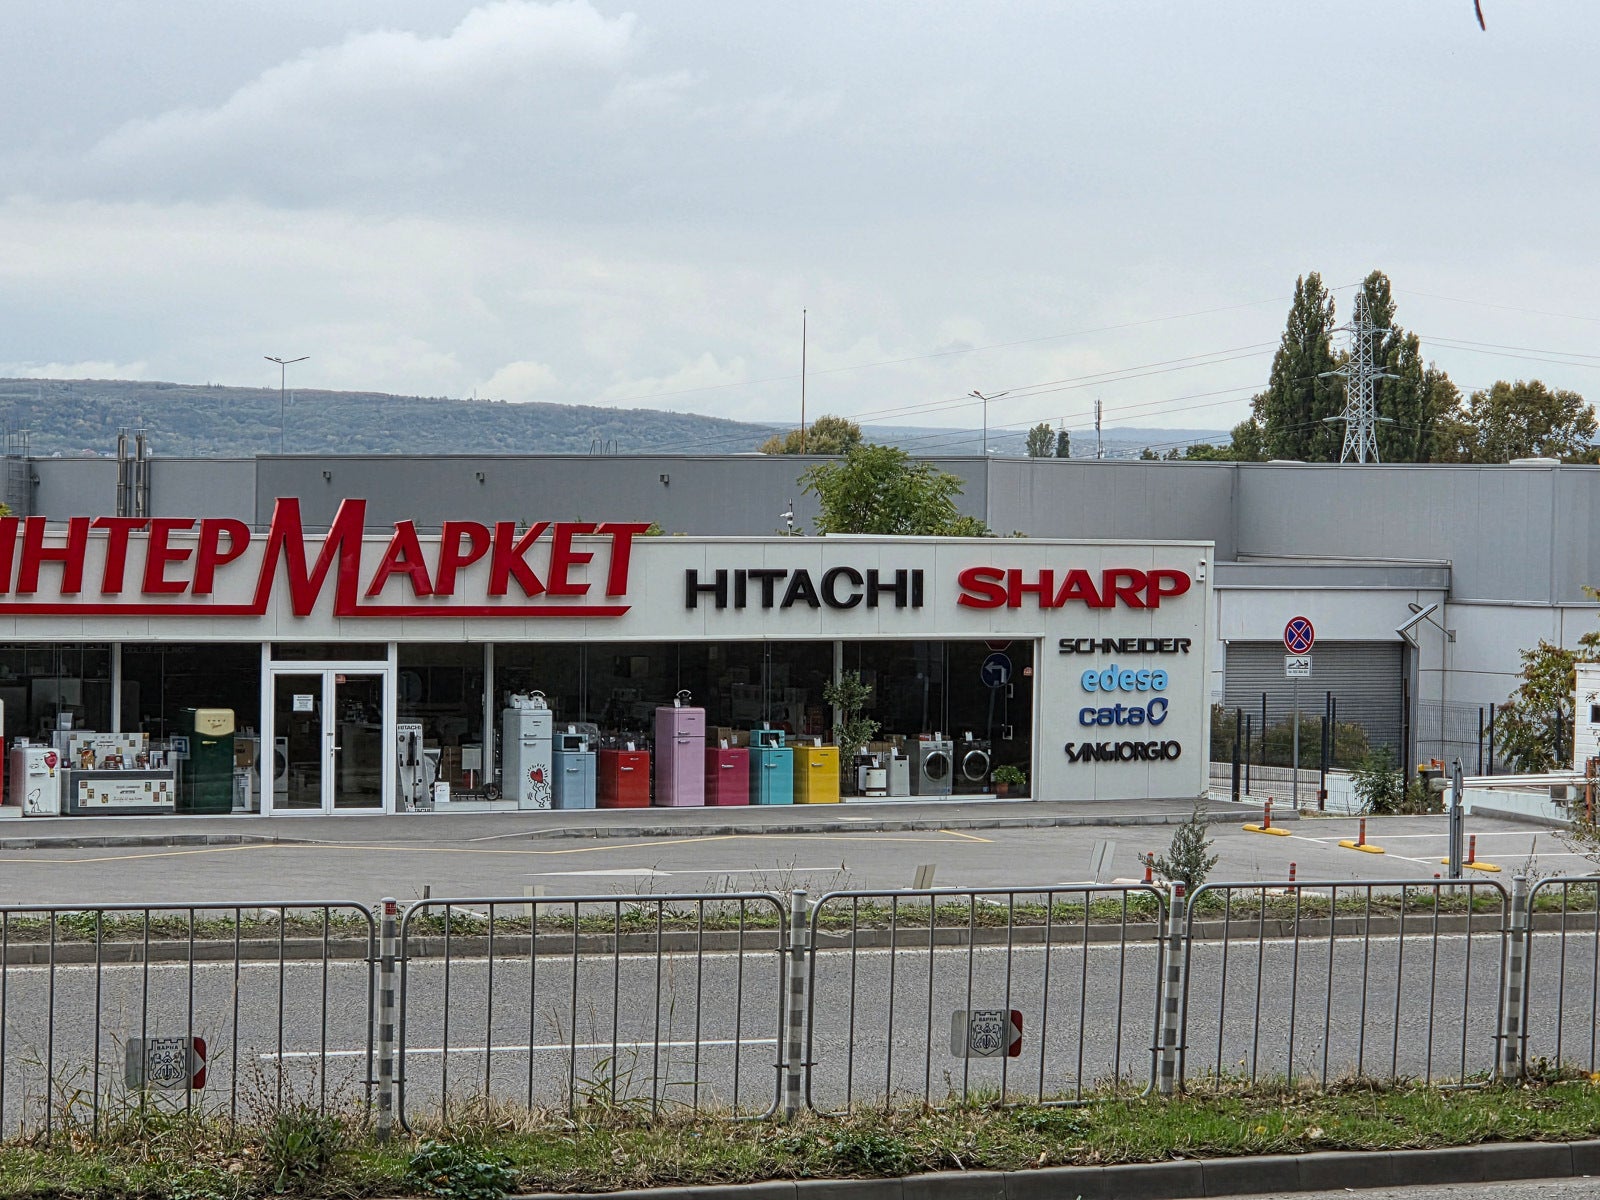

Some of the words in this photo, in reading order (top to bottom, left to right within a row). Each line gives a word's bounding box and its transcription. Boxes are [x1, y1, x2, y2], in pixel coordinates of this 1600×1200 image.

[685, 566, 924, 609] HITACHI
[957, 566, 1191, 609] SHARP
[1059, 638, 1192, 654] SCHNEIDER
[1081, 664, 1169, 692] edesa
[1079, 703, 1145, 726] cata
[1065, 740, 1181, 762] SANGIORGIO
